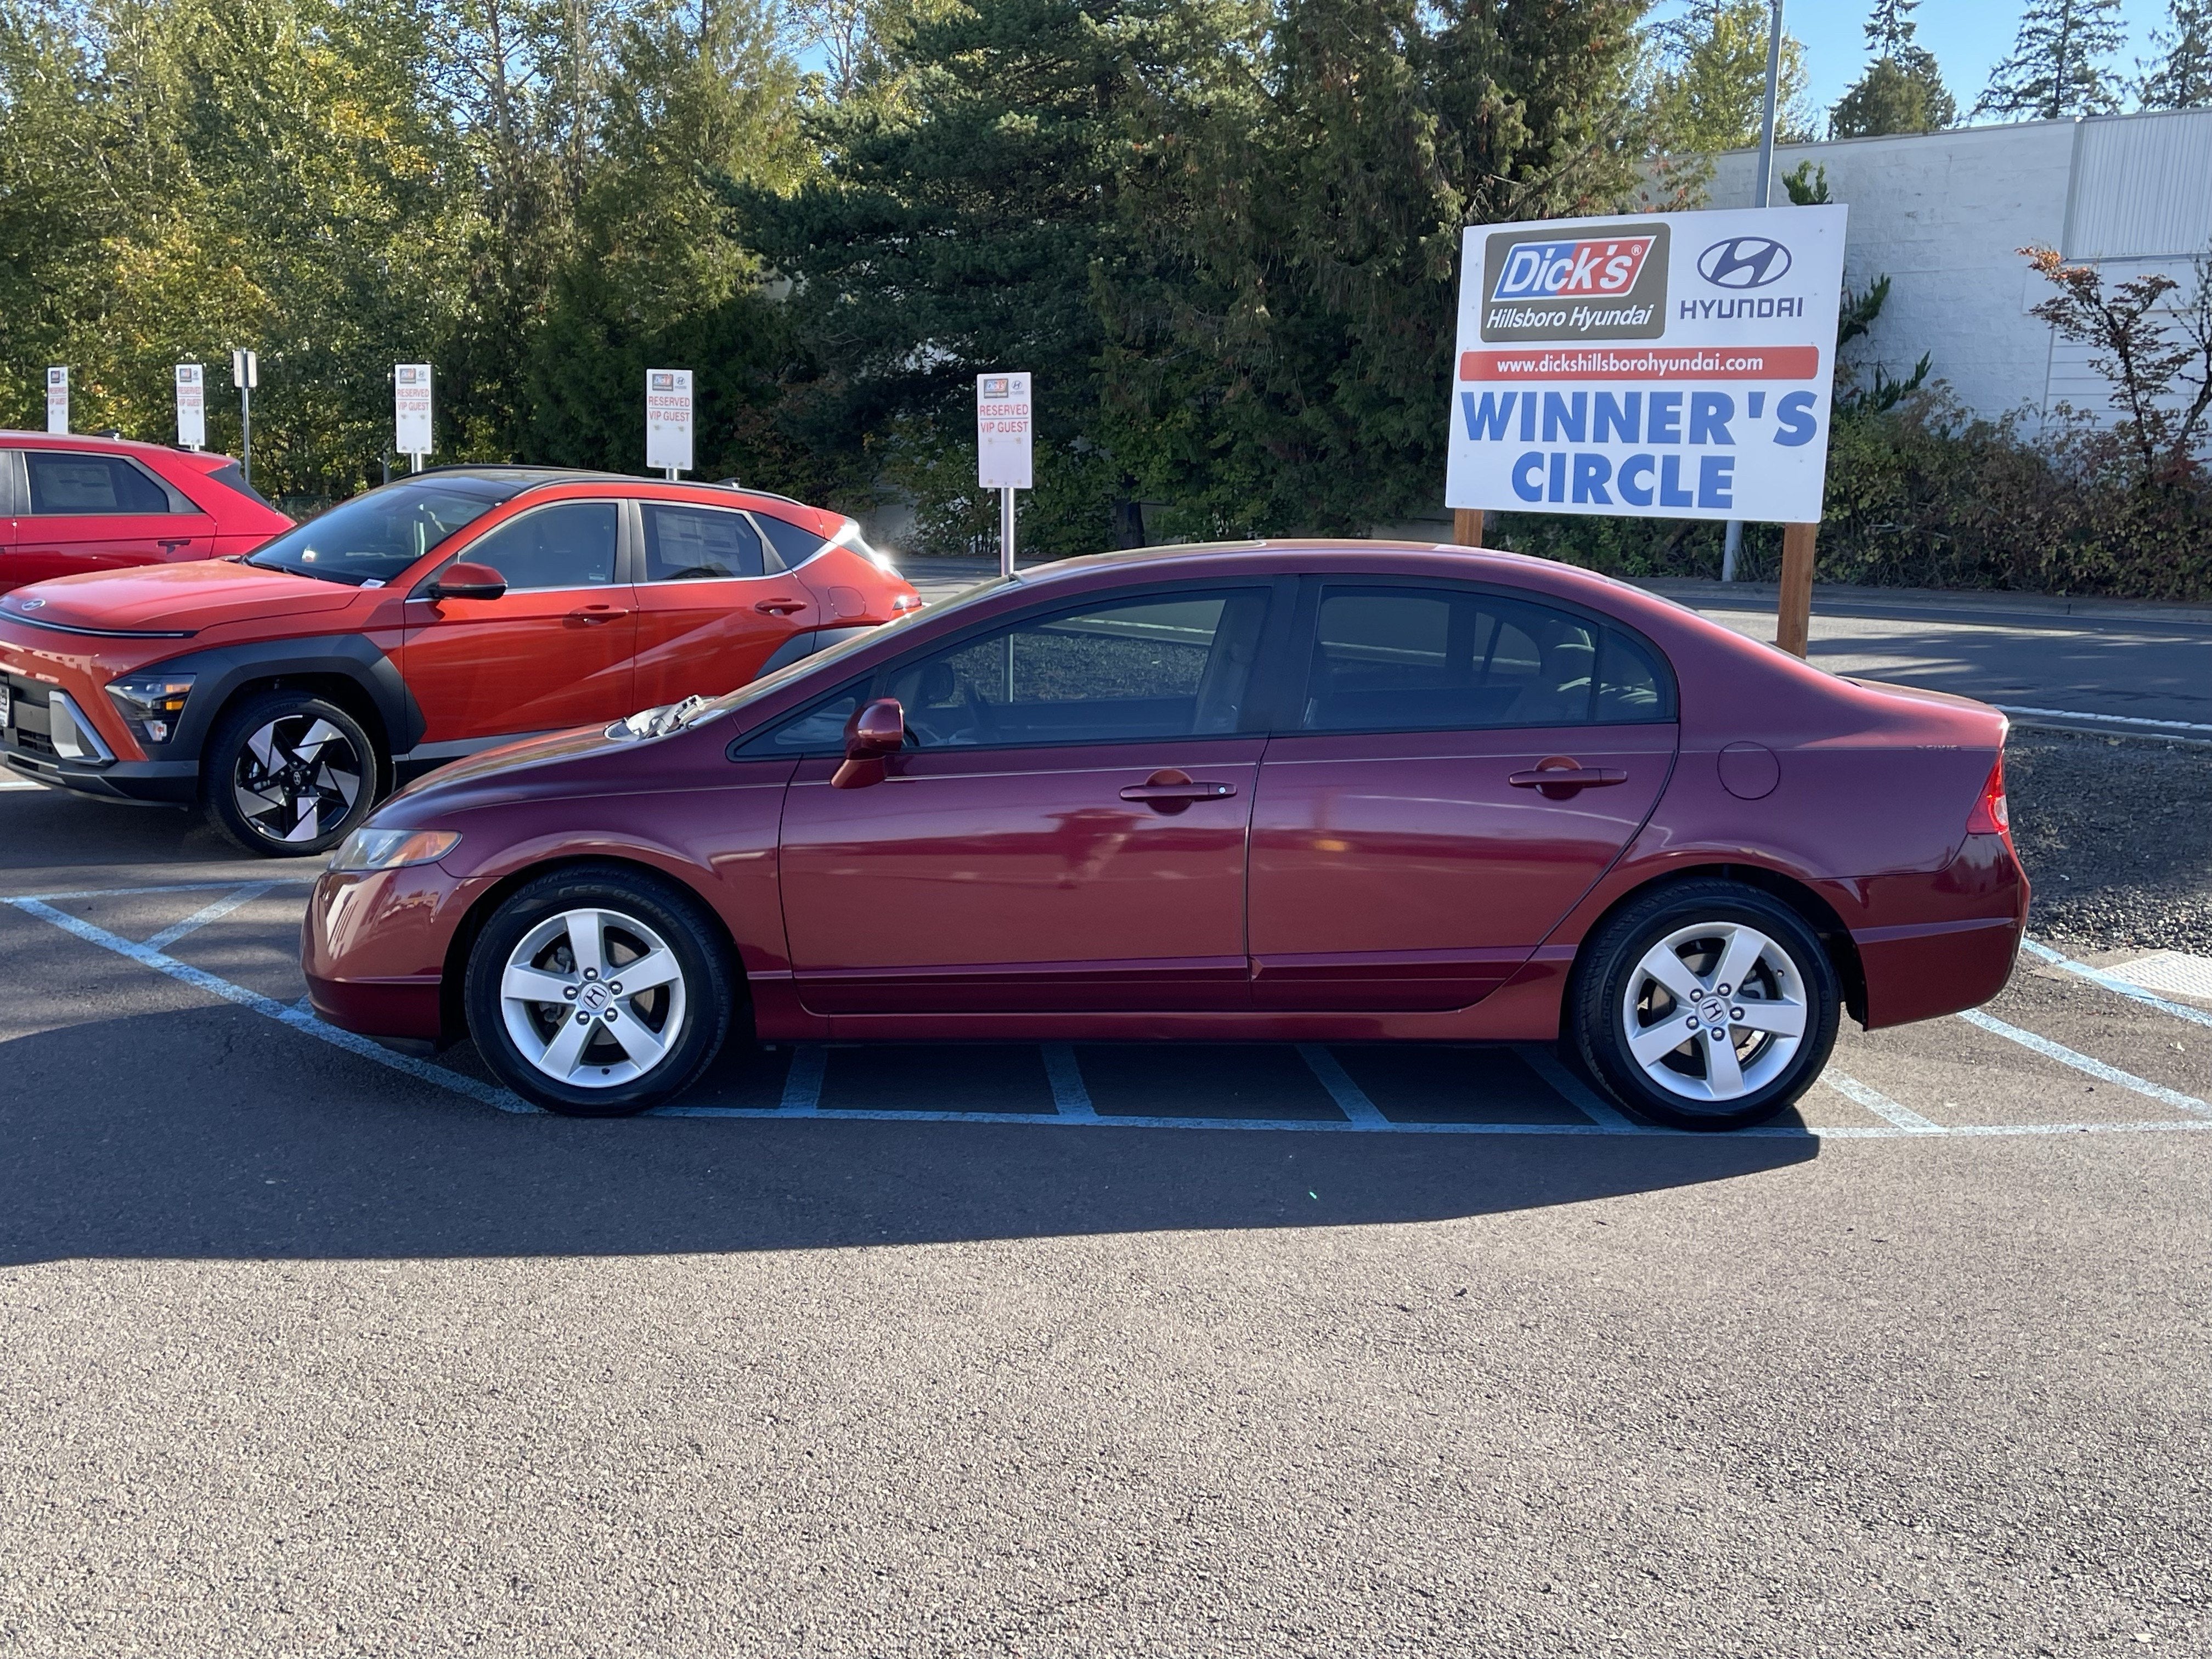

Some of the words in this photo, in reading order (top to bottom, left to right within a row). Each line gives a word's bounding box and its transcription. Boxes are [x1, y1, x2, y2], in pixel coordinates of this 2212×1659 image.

[1503, 245, 1633, 292] Dick's
[1680, 297, 1803, 319] HYUNDAI
[1486, 307, 1566, 328] Hillsboro
[1569, 304, 1655, 331] Hyundai
[1497, 352, 1763, 376] www.dickshillsborohyundai.com
[397, 388, 429, 397] RESERVED
[397, 402, 407, 410] VIP
[409, 402, 429, 411] GUEST
[648, 396, 690, 407] RESERVED
[980, 404, 1028, 416] RESERVED
[649, 410, 661, 420] VIP
[663, 411, 690, 422] GUEST
[1460, 391, 1818, 447] WINNER'S
[980, 422, 994, 432] VIP
[998, 421, 1028, 432] GUEST
[1511, 452, 1736, 509] CIRCLE
